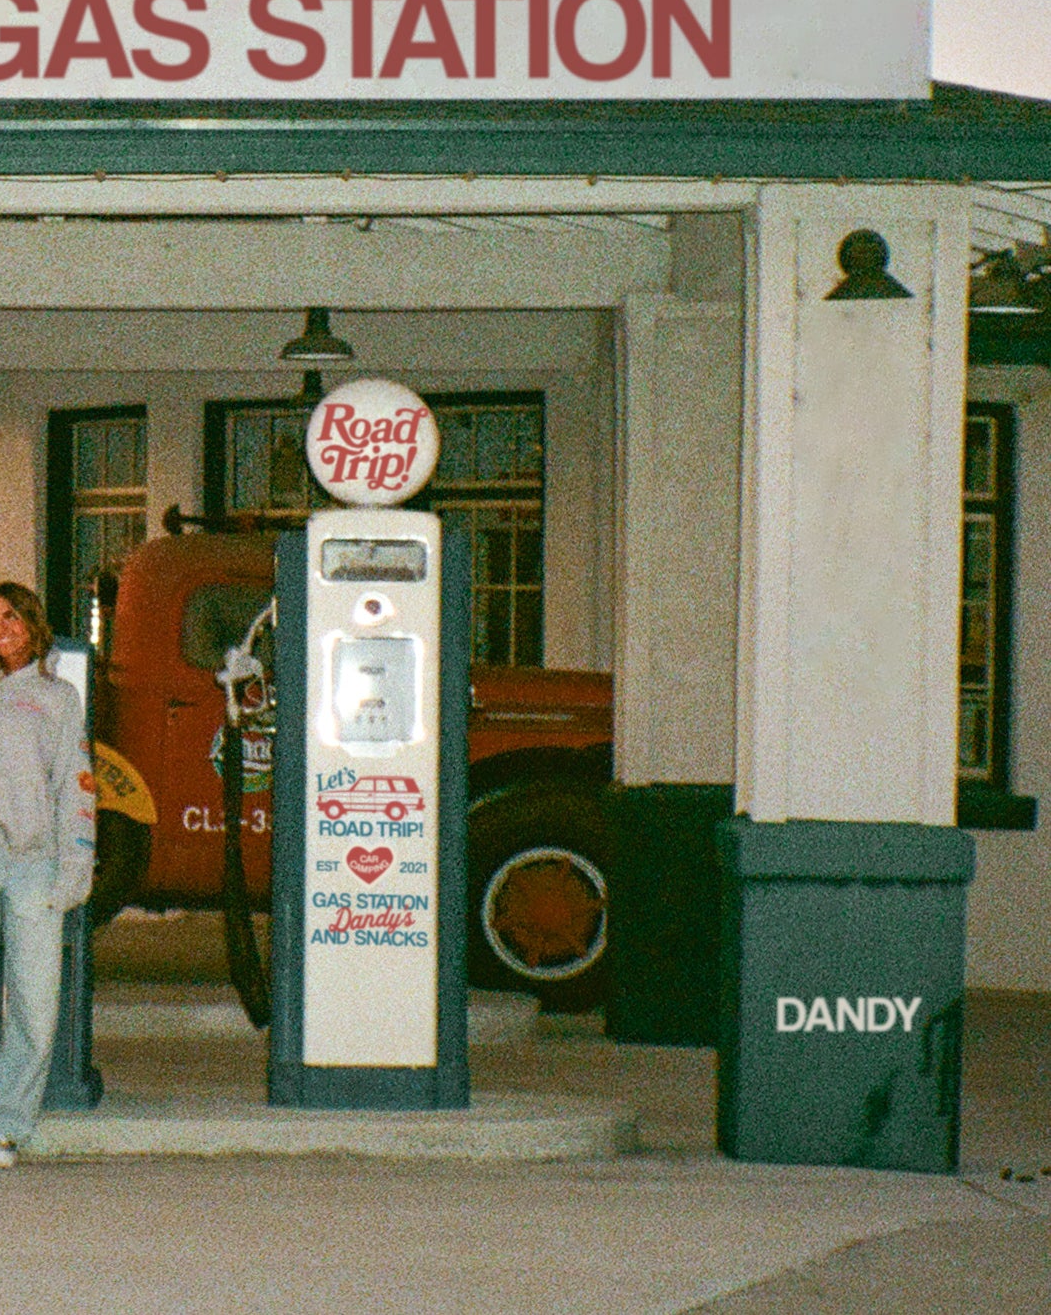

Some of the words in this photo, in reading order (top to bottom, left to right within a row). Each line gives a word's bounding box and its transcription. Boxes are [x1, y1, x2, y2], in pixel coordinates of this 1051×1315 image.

[316, 403, 429, 448] Road
[321, 445, 418, 491] Trip!
[316, 767, 357, 792] Let's
[319, 820, 373, 837] ROAD
[376, 821, 424, 838] TRIP!
[316, 860, 340, 872] EST
[348, 859, 390, 874] CAMPING
[359, 854, 379, 864] CAR
[399, 861, 428, 874] 2021
[312, 891, 352, 909] GAS
[356, 893, 429, 911] STATION
[329, 904, 416, 935] Dandy's
[311, 929, 350, 945] AND
[354, 930, 428, 948] SNACKS
[776, 996, 923, 1032] DANDY
